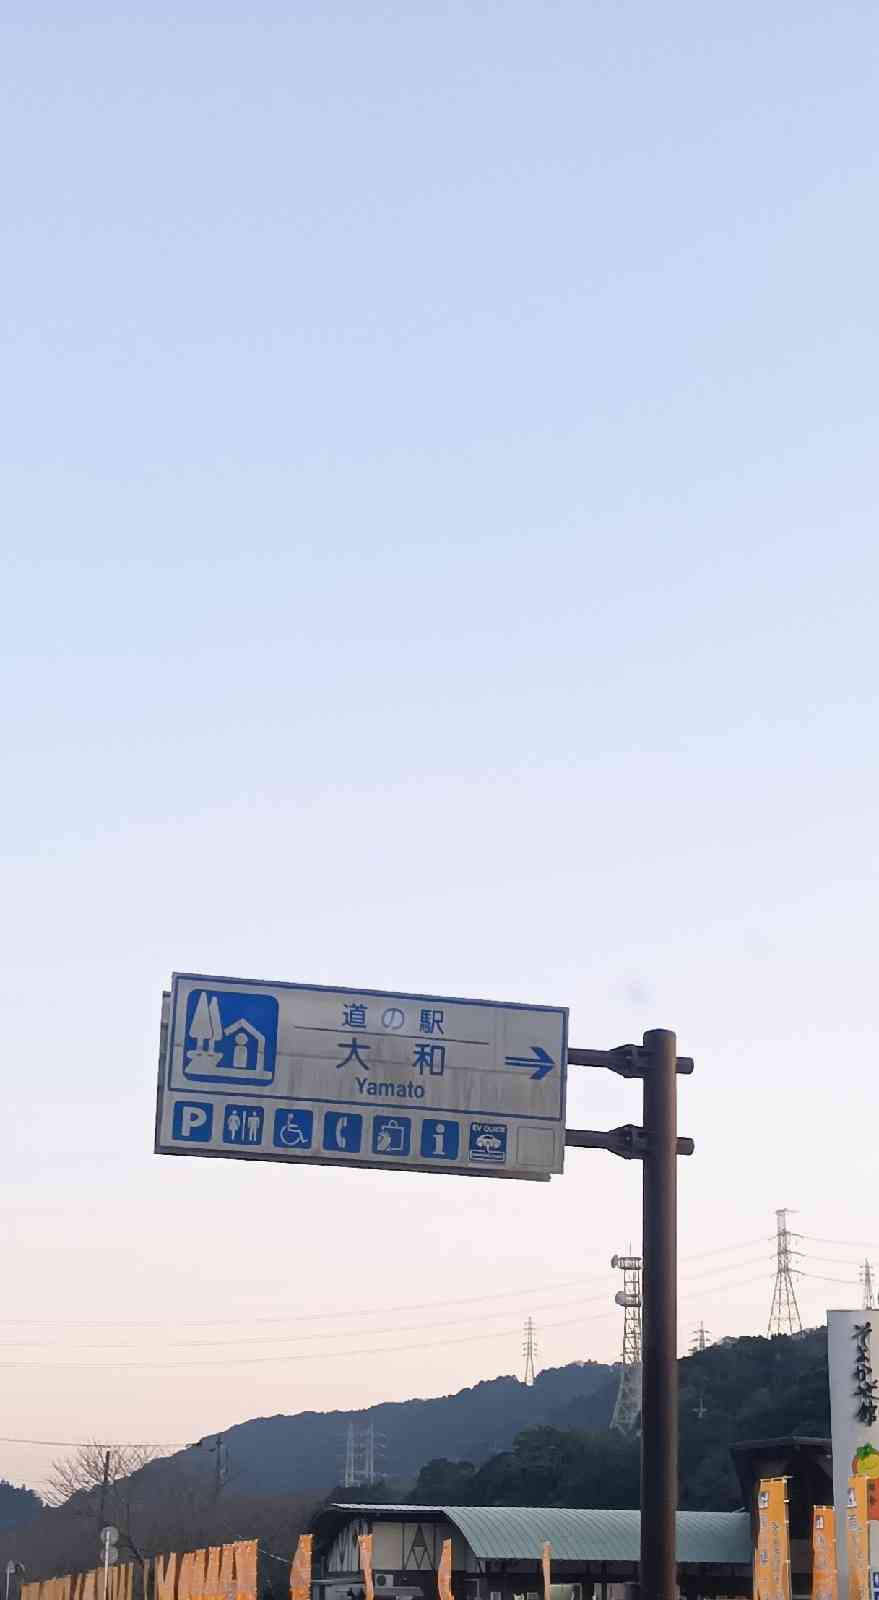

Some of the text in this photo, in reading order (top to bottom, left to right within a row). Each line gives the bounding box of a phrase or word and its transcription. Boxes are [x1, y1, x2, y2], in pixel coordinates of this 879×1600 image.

[342, 1003, 444, 1034] 道の駅
[336, 1037, 446, 1076] 大和
[355, 1077, 425, 1099] Yamato
[182, 1106, 207, 1137] P
